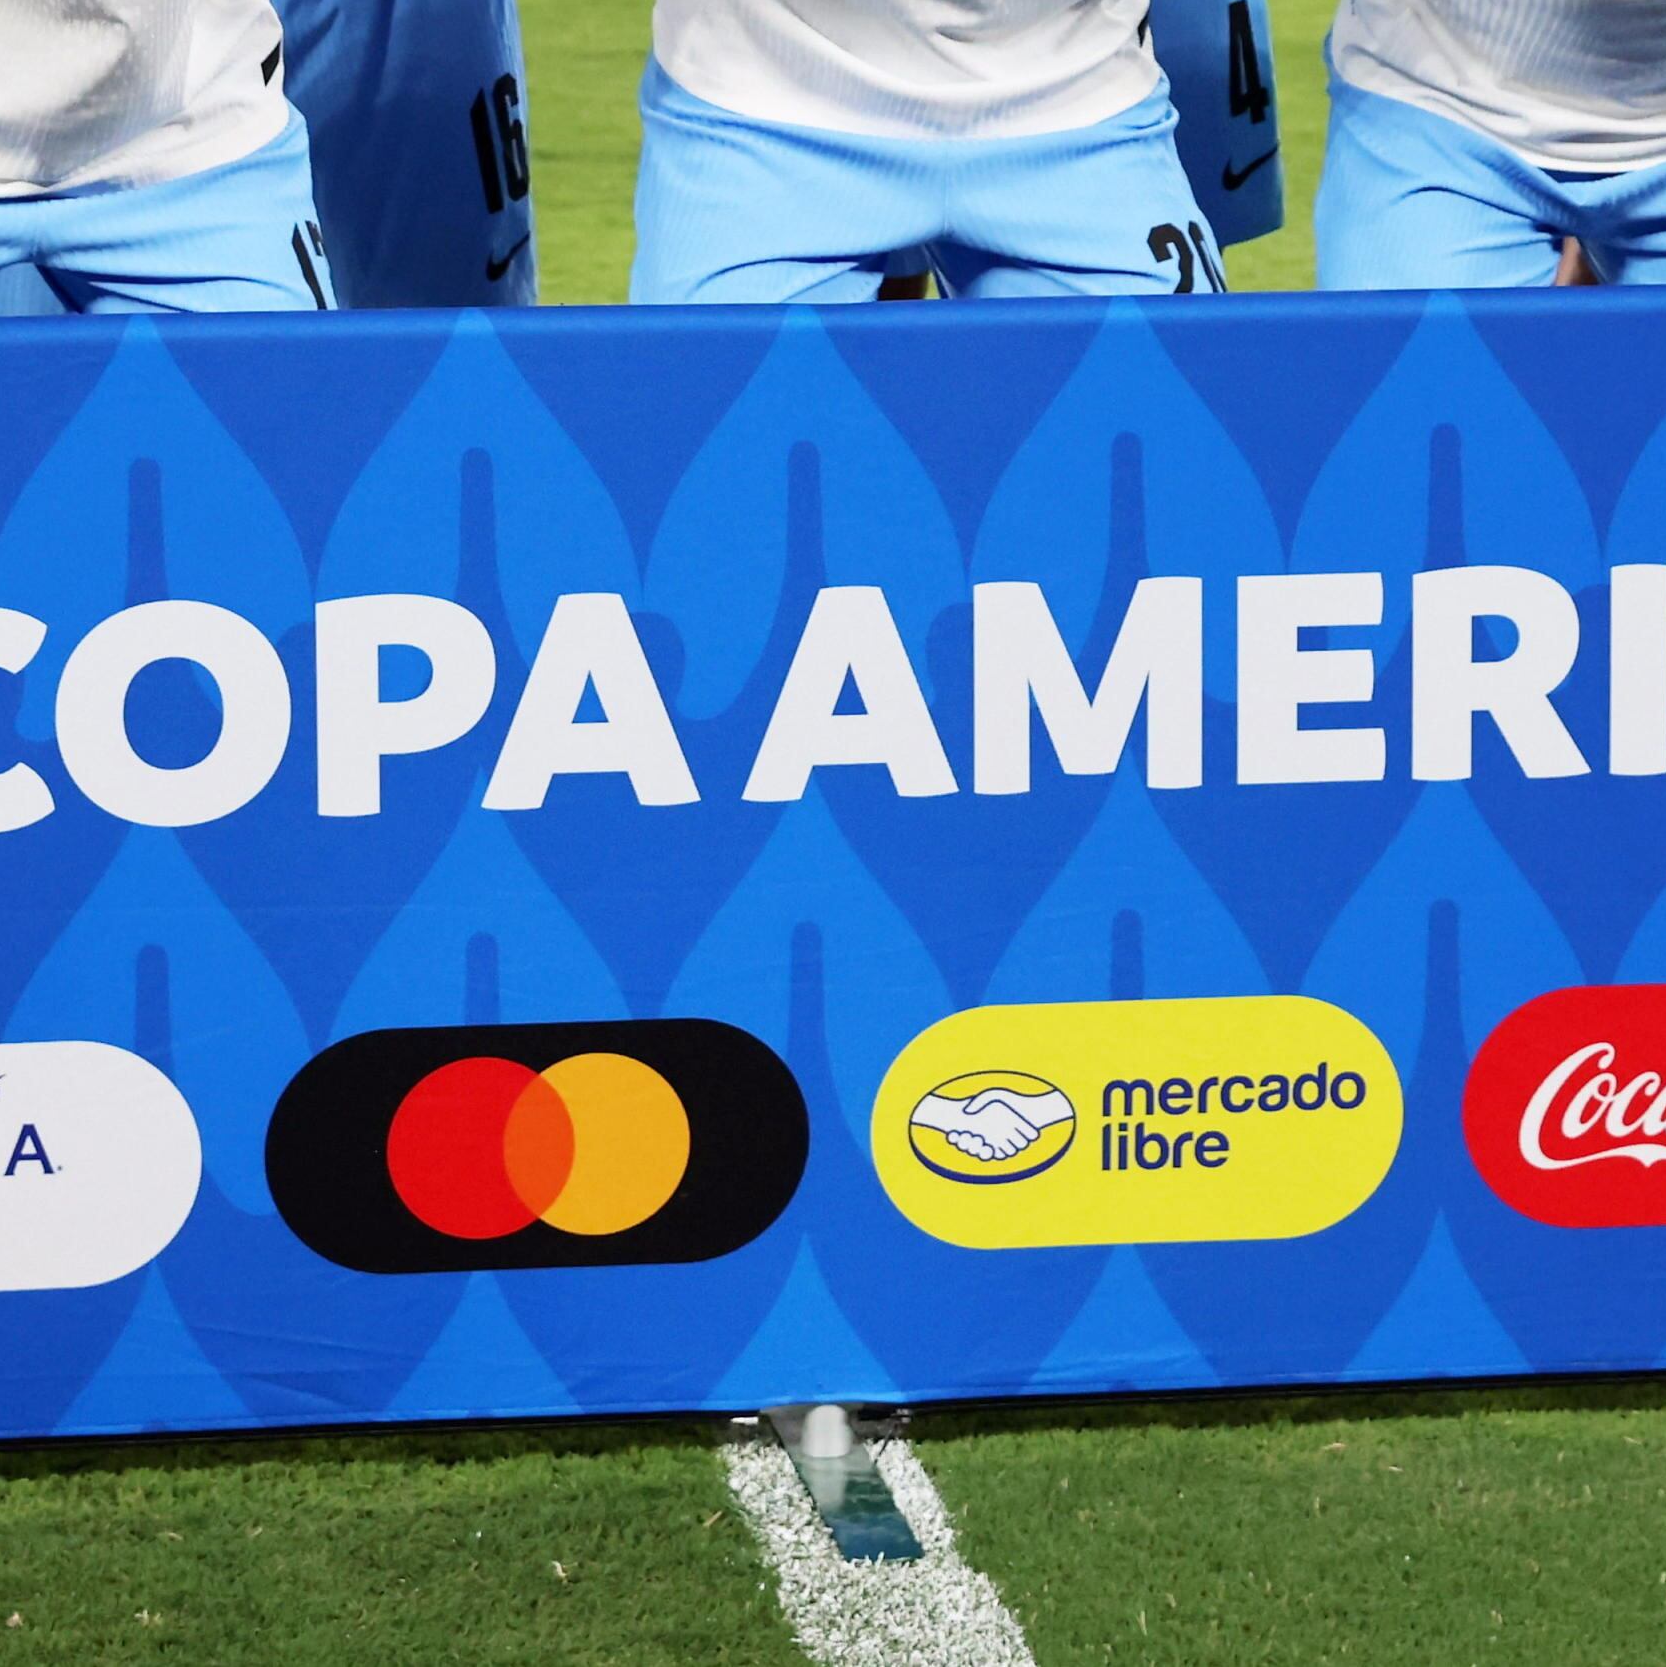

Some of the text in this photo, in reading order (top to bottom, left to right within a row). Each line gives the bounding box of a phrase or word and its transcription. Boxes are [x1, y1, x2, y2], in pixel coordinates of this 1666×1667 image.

[470, 72, 530, 215] 16
[1102, 1061, 1366, 1117] mercado
[1101, 1122, 1230, 1171] libre
